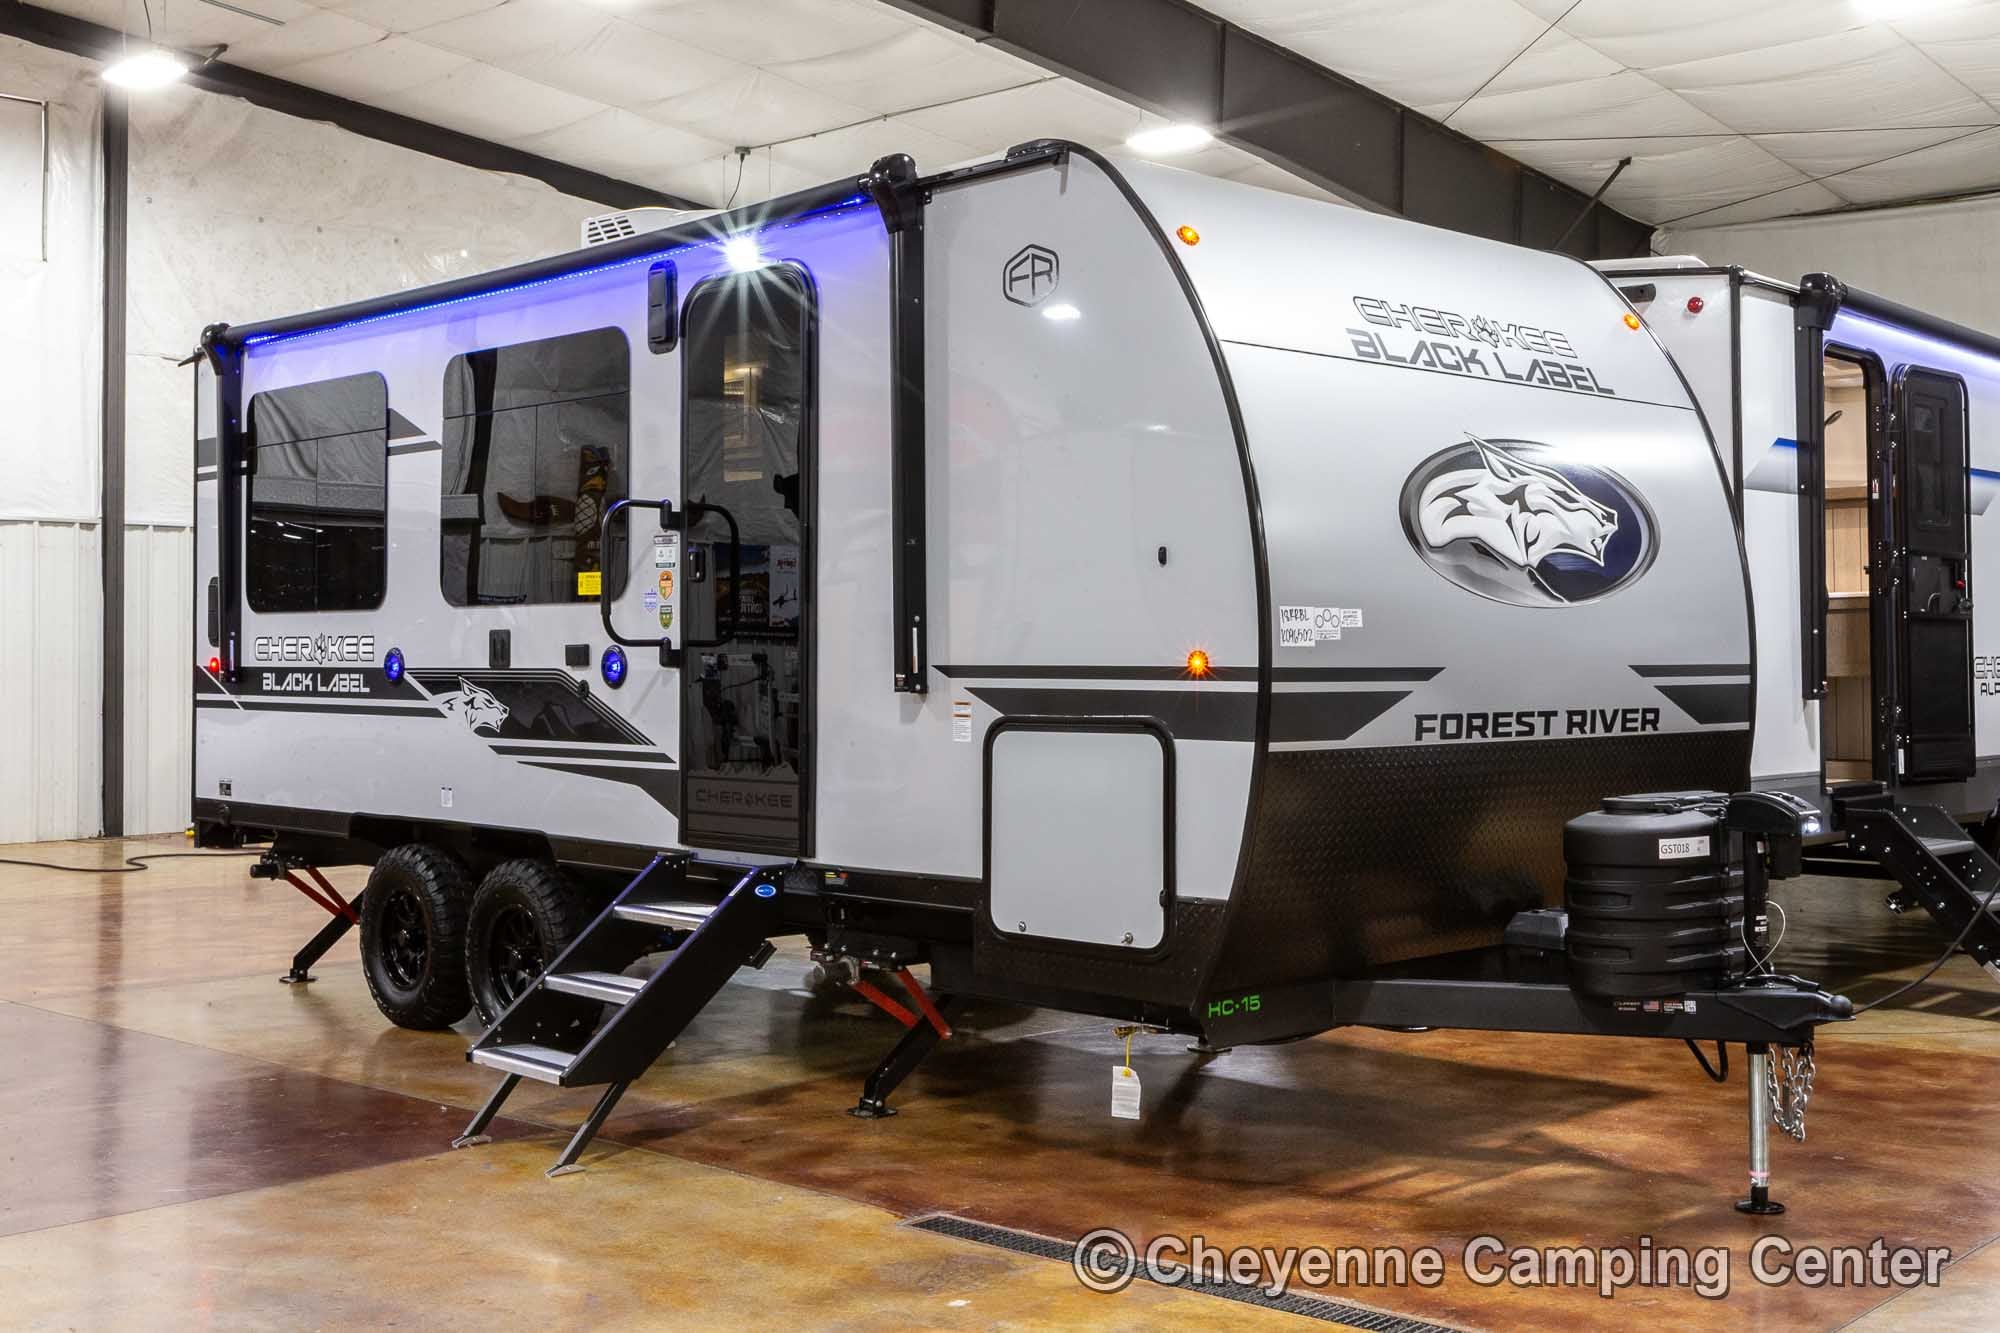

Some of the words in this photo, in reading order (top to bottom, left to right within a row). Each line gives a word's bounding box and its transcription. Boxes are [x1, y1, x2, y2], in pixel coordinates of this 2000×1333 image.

[1353, 296, 1577, 359] CHEROKEE
[1346, 329, 1490, 376] BLACK
[1499, 353, 1615, 396] LABEL
[254, 633, 375, 665] CHEROKEE
[262, 672, 314, 693] BLACK
[317, 672, 371, 693] LABEL
[1414, 710, 1558, 742] FOREST
[1566, 707, 1660, 736] RIVER
[1660, 843, 1690, 855] GST018
